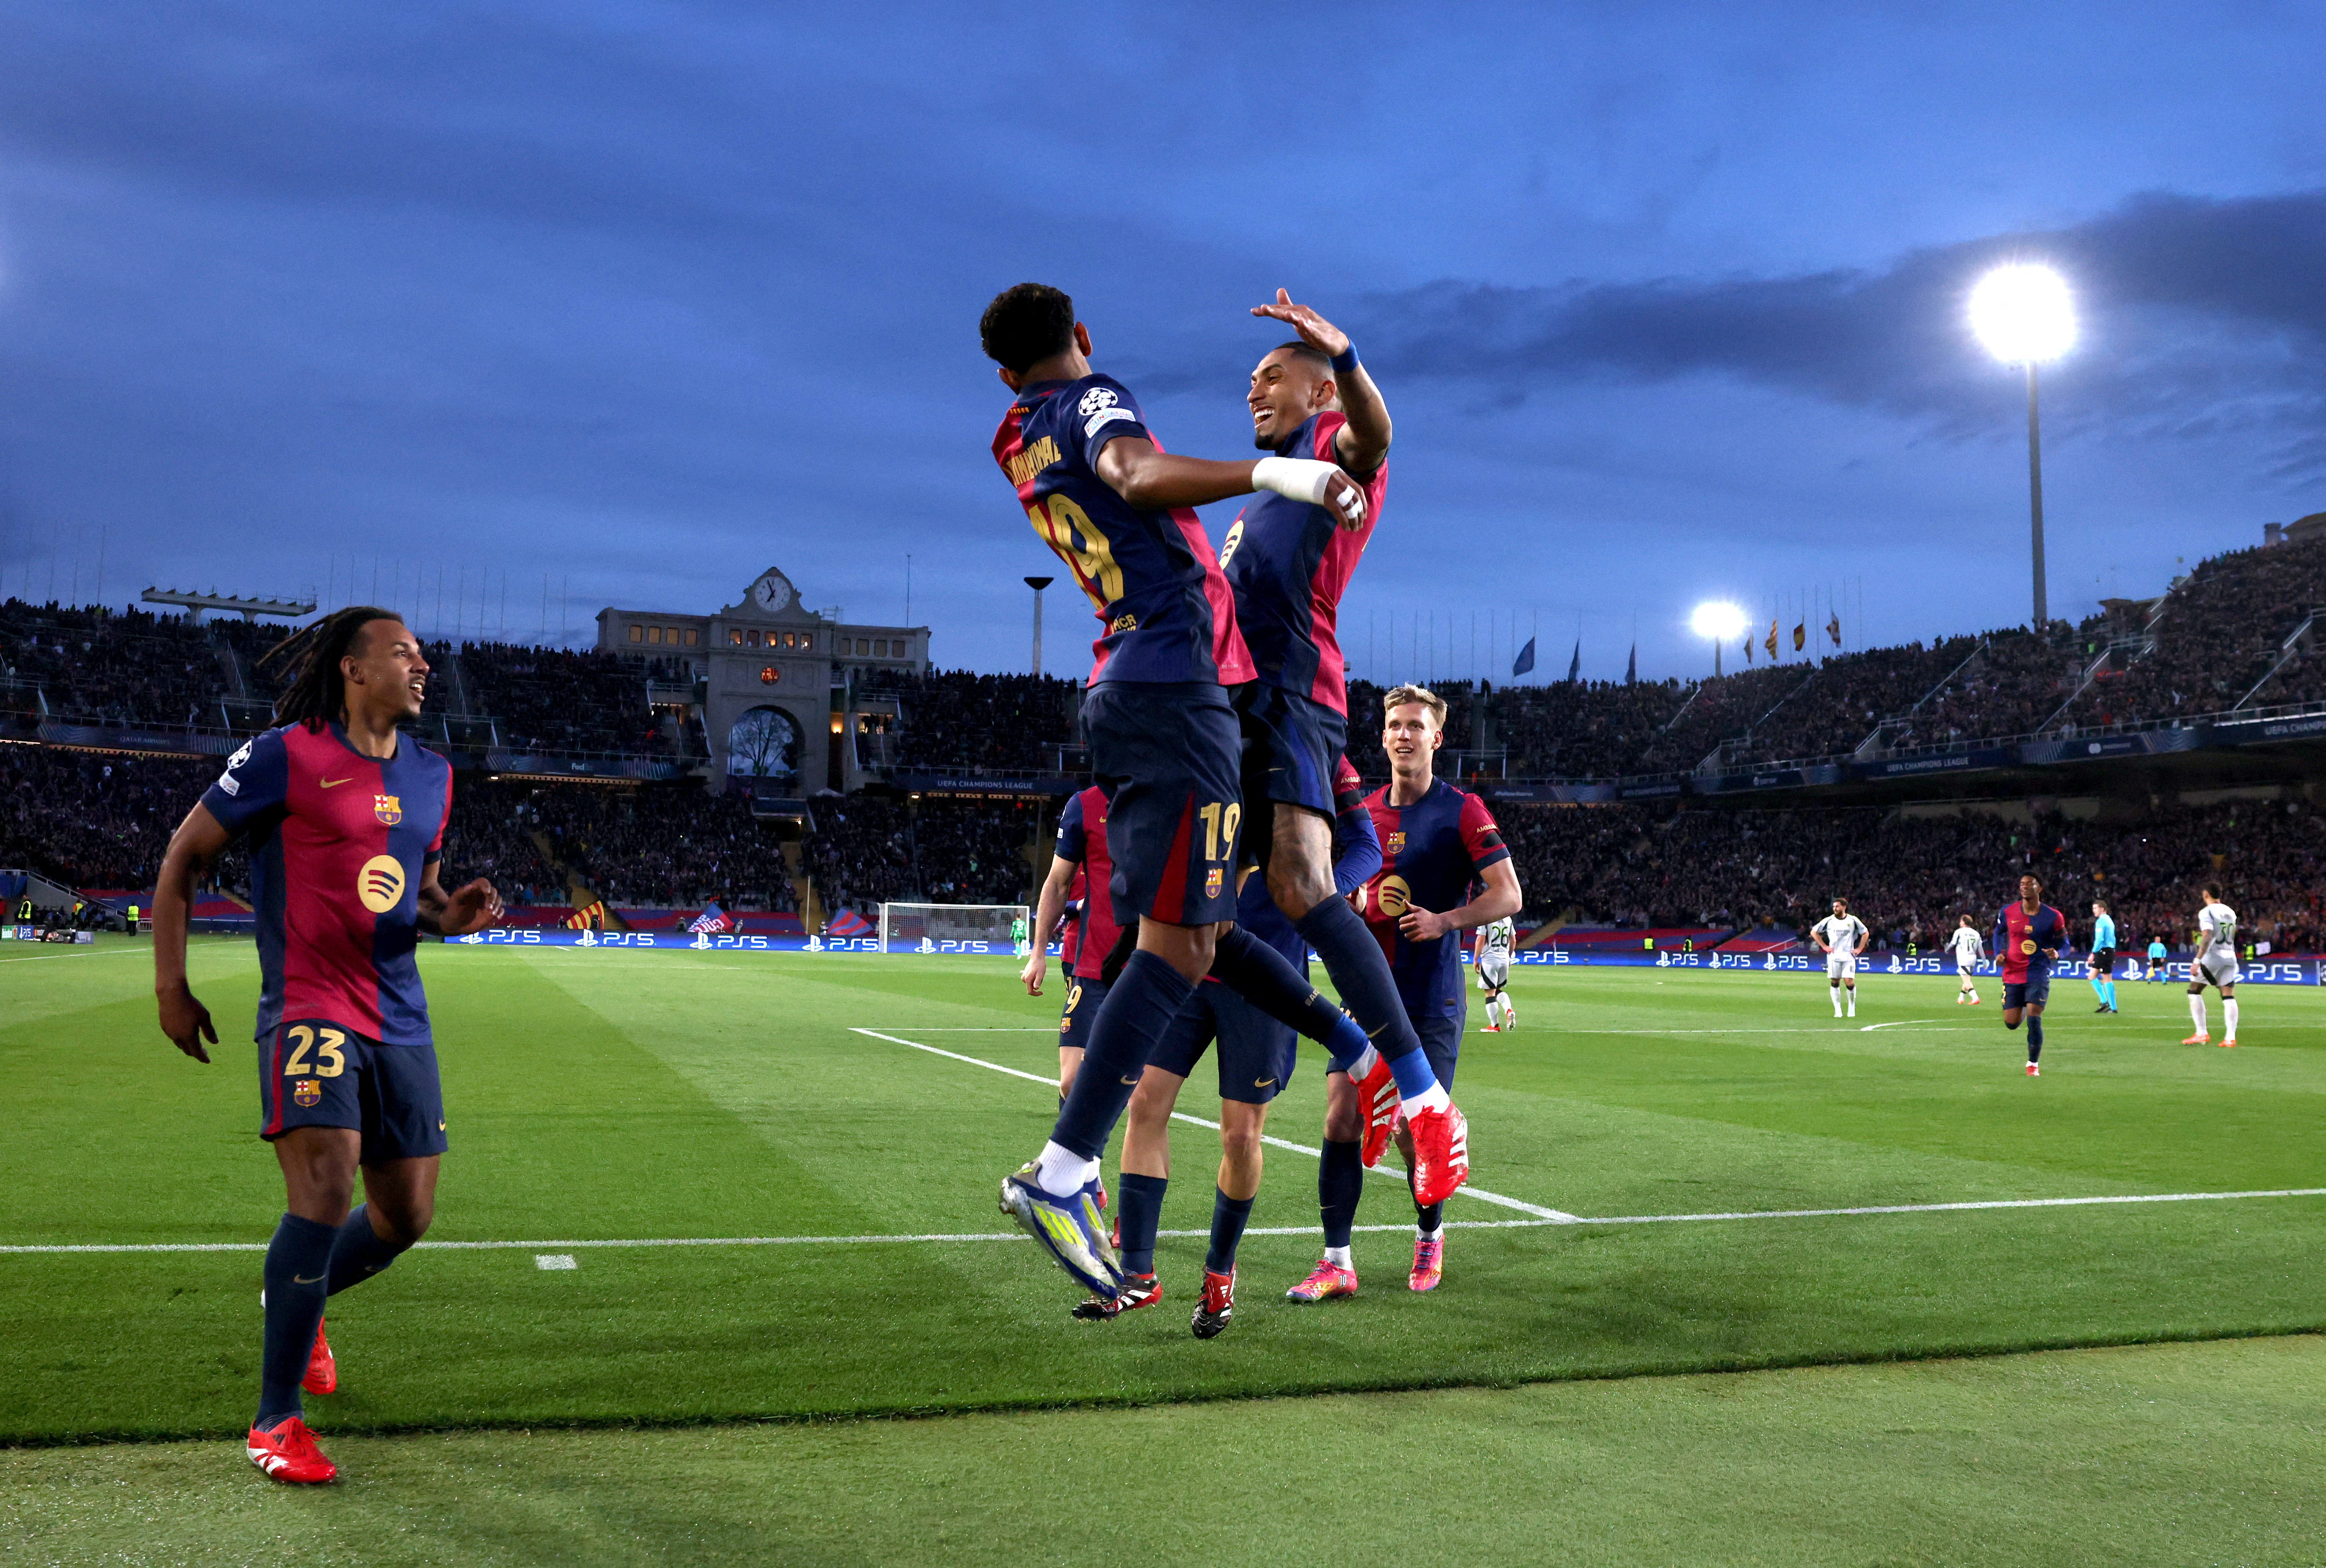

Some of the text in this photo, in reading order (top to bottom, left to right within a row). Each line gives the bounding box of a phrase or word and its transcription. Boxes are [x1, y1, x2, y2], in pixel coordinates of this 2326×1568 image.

[1087, 410, 1133, 433] FOUNDATION
[1200, 802, 1241, 861] 19
[489, 930, 541, 943] PS5
[604, 932, 654, 946] PS5
[718, 935, 767, 949] PS5
[1491, 926, 1509, 948] 26
[829, 937, 878, 951] PS5
[941, 940, 989, 953] PS5
[1524, 951, 1569, 963] PS5
[1672, 953, 1699, 966] PS5
[1723, 954, 1751, 967] PS5
[1779, 955, 1808, 969] PS5
[1905, 957, 1941, 972] PS5
[2249, 963, 2302, 981] PS5
[1065, 985, 1082, 1014] 9
[284, 1025, 345, 1078] 23
[1339, 1274, 1347, 1287] 10
